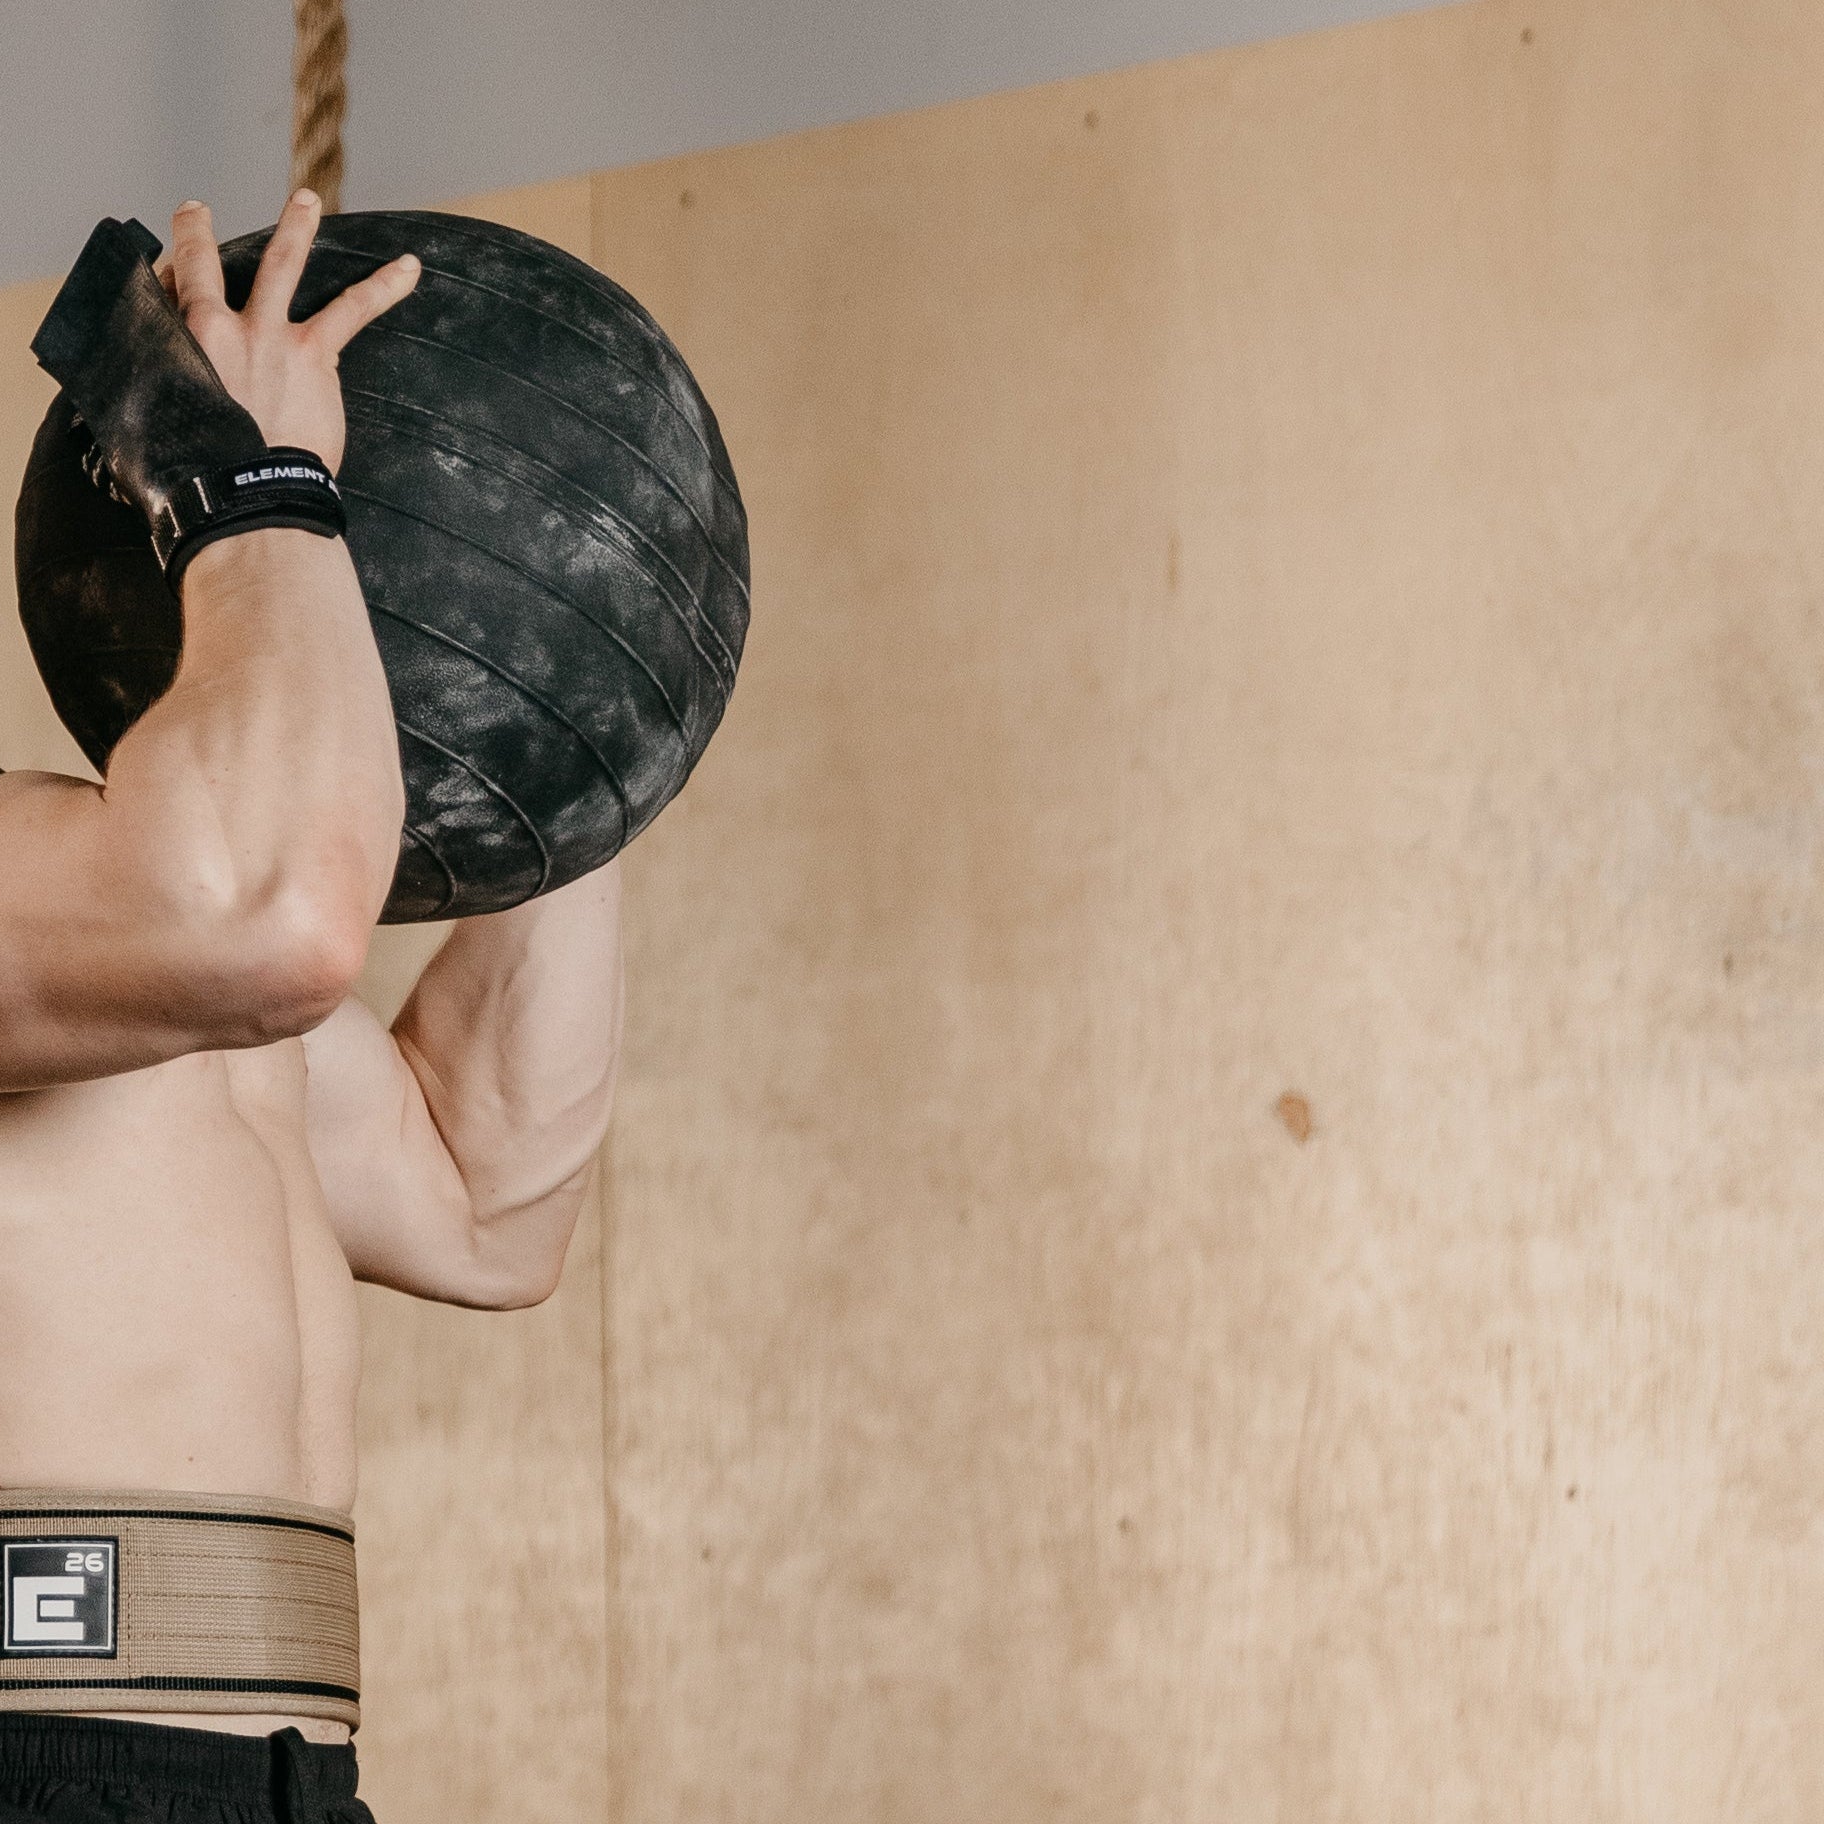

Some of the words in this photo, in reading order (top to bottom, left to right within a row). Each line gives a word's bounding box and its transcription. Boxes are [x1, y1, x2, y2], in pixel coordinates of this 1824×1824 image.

[234, 466, 326, 486] ELEMENT
[64, 1552, 105, 1573] 26
[12, 1576, 85, 1641] E
